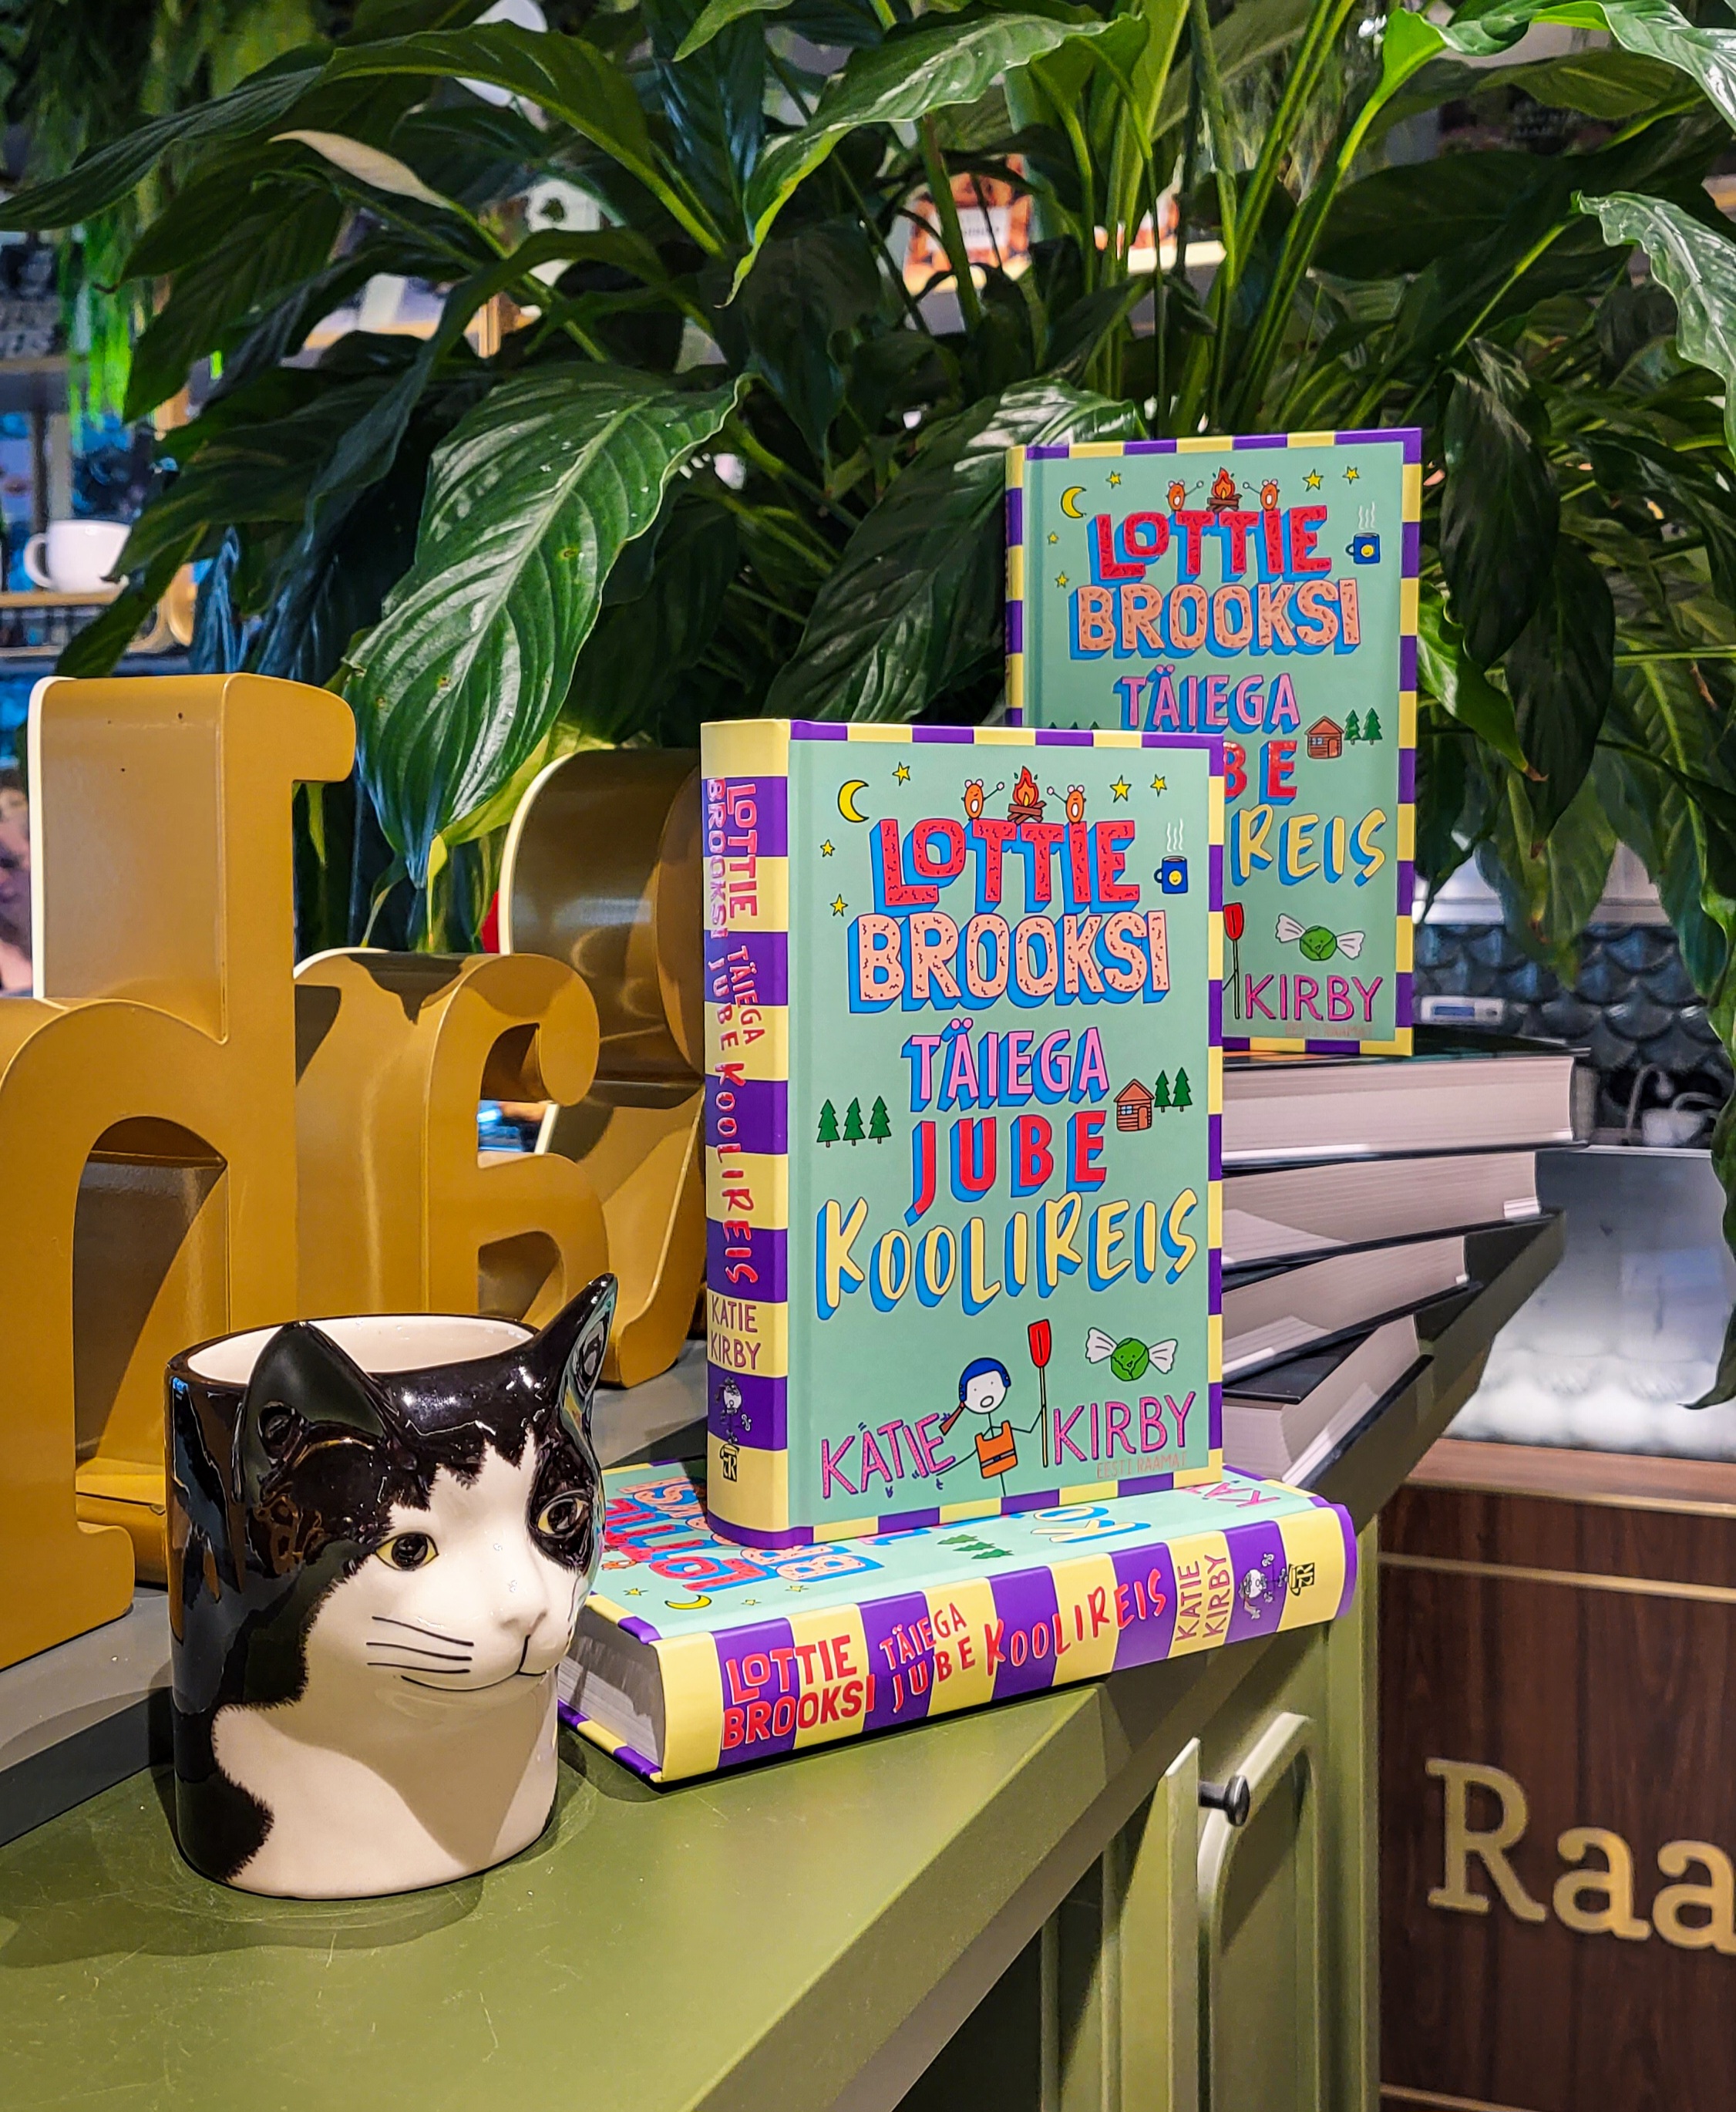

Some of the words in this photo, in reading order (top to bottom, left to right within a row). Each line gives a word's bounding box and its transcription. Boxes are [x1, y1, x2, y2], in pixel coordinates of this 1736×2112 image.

[1086, 504, 1331, 585] LOTTIE
[1068, 578, 1361, 659] BROOKSI
[1113, 664, 1300, 733] TÄIEGA
[707, 778, 728, 939] BROOKSI
[726, 783, 758, 919] LOTTIE
[870, 818, 1140, 916] LOTTIE
[1230, 803, 1386, 886] REIS
[726, 945, 765, 1046] TÄIEGA
[848, 911, 1170, 1013] BROOKSI
[1245, 974, 1383, 1021] KIRBY
[708, 957, 739, 1052] JUBE
[900, 1018, 1109, 1112] TÄIEGA
[715, 1062, 759, 1284] KOOLIREIS
[904, 1110, 1107, 1226] JUBE
[816, 1187, 1197, 1320] KOOLIREIS
[711, 1329, 761, 1371] KIRBY
[712, 1295, 758, 1334] KATIE
[821, 1413, 955, 1499] KATIE
[1053, 1391, 1196, 1465] KIRBY
[1097, 1458, 1132, 1479] EESTI
[1137, 1450, 1187, 1473] RAAMAT
[880, 1602, 967, 1670] TÄIEGA
[984, 1568, 1167, 1676] KOOLIREIS
[1175, 1560, 1200, 1642] KATIE
[1202, 1555, 1231, 1639] KIRBY
[725, 1635, 857, 1705] LOTTIE
[892, 1635, 976, 1714] JUBE
[722, 1674, 875, 1750] BROOKSI
